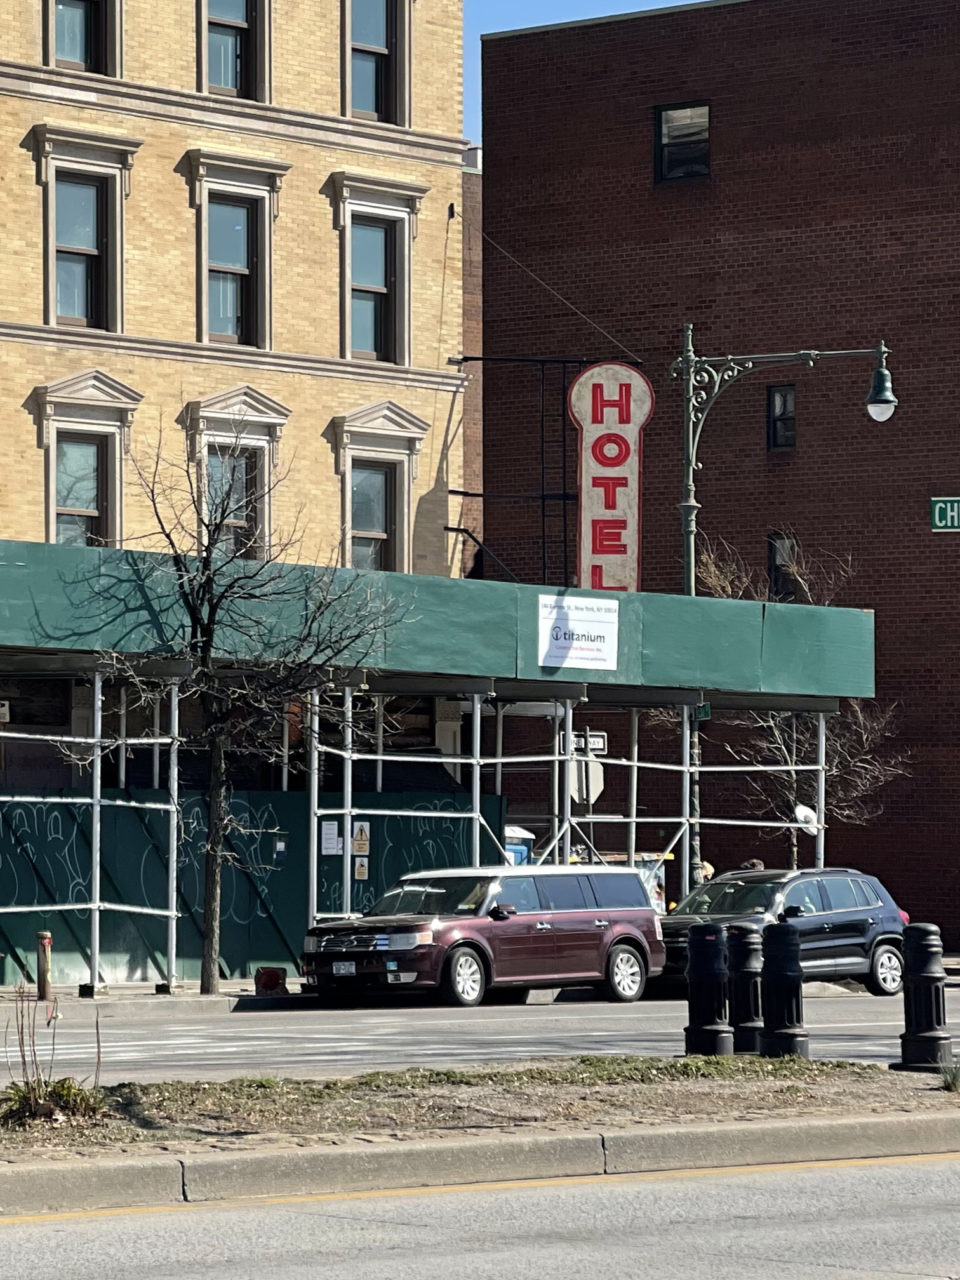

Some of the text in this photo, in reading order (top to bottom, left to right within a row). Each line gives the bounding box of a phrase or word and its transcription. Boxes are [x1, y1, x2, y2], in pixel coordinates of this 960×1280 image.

[591, 383, 631, 591] HOTEL
[935, 502, 960, 527] CH
[563, 629, 605, 643] titanium
